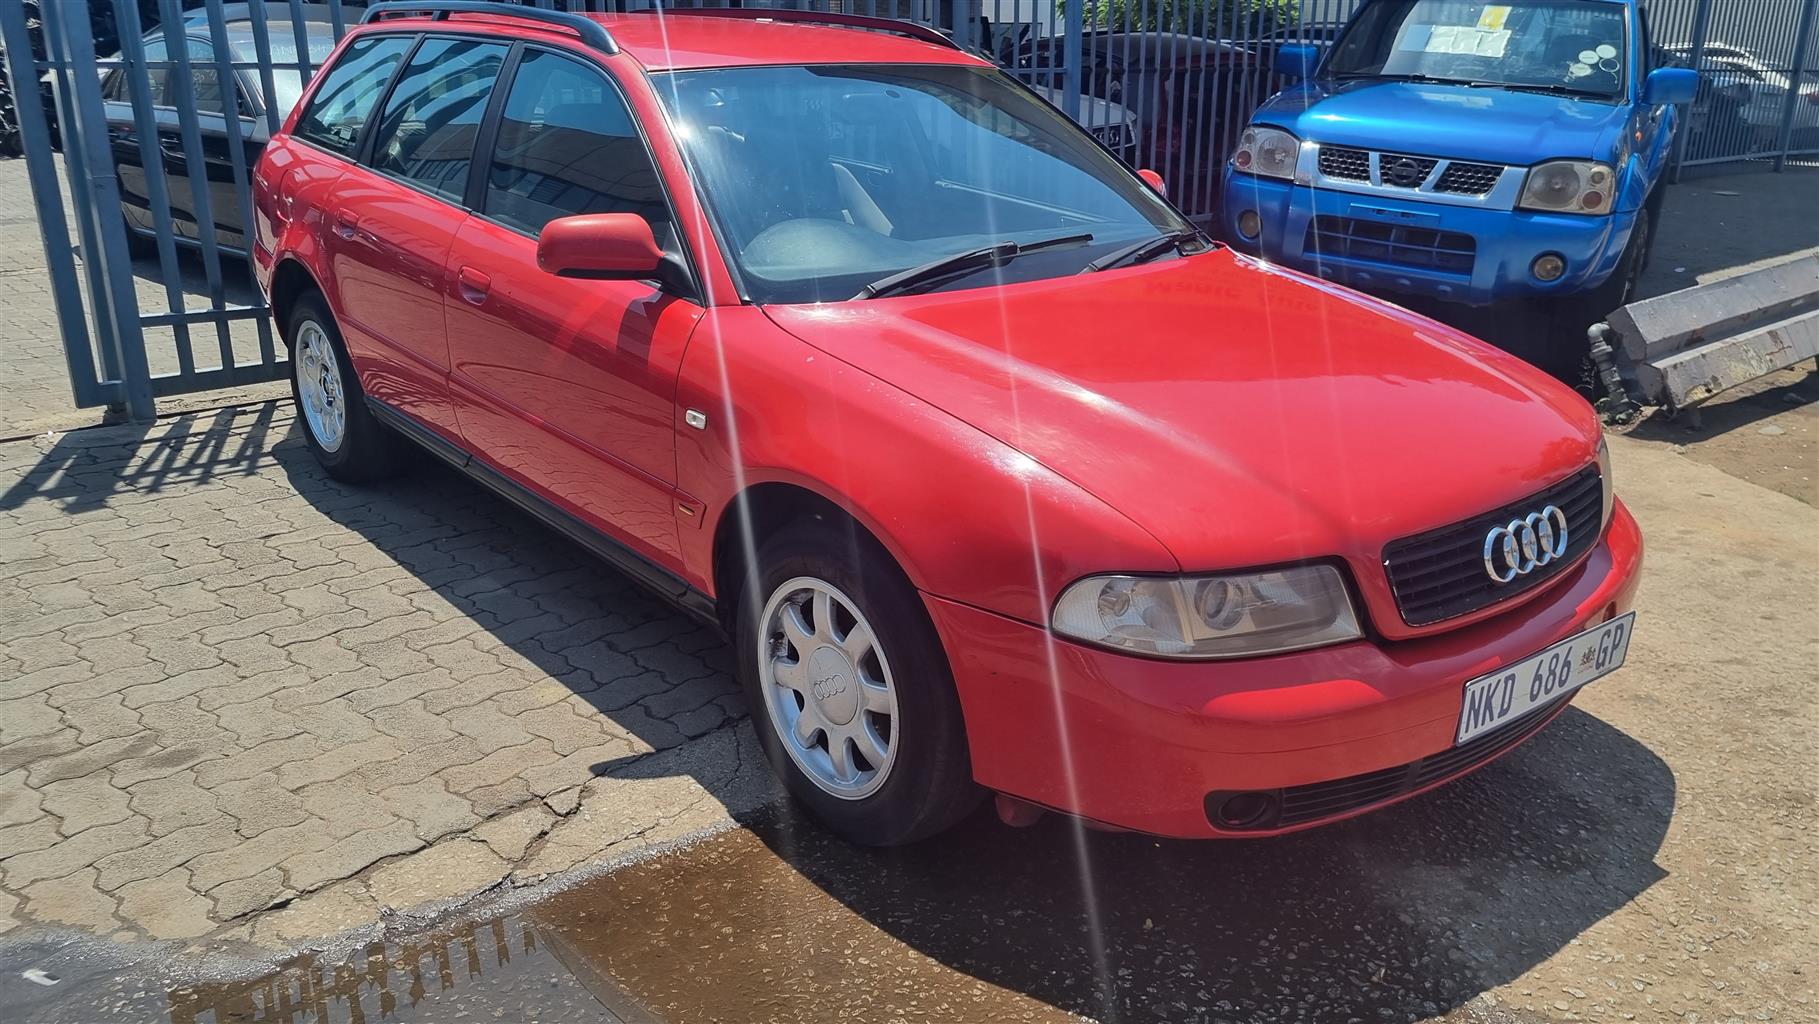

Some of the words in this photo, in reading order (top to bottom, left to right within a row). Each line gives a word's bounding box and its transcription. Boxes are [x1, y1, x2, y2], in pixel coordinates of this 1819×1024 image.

[1465, 674, 1516, 734] NKD
[1530, 646, 1573, 703] 686
[1595, 623, 1625, 671] GP
